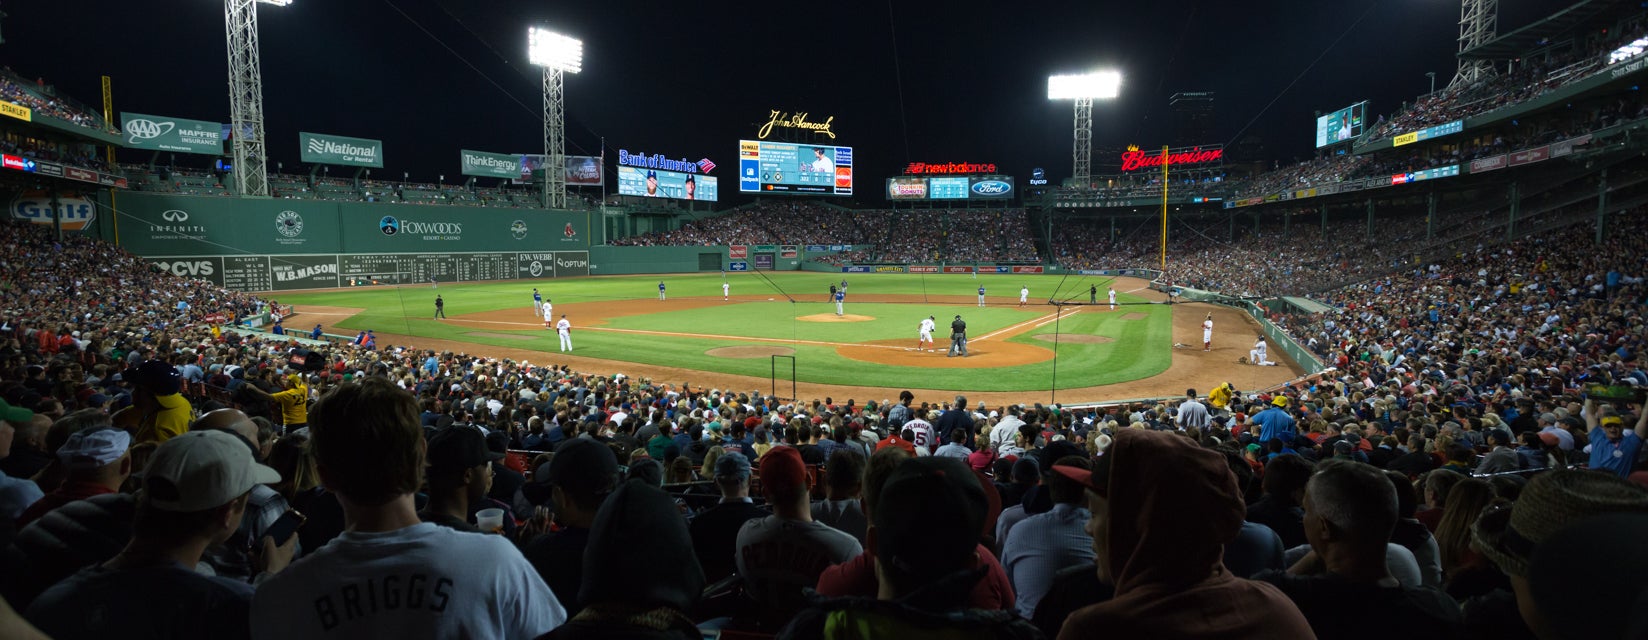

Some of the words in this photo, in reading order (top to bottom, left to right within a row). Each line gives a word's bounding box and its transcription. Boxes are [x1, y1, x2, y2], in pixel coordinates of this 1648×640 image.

[1, 103, 27, 117] STANLEY
[131, 119, 156, 137] AAA
[758, 109, 790, 139] John
[790, 112, 836, 139] Hancock
[178, 129, 218, 138] MAPFRE
[1396, 135, 1414, 144] STANLEY
[182, 138, 216, 146] INSURANCE
[324, 141, 375, 157] National
[619, 149, 648, 167] Bank
[648, 154, 658, 168] of
[659, 155, 697, 173] America
[1121, 147, 1223, 171] Budweiser
[978, 182, 1002, 194] Ford
[17, 201, 89, 219] Gulf
[401, 220, 462, 234] FOXWOODS
[172, 261, 214, 276] CVS
[564, 260, 586, 268] OPTUM
[314, 574, 453, 631] BRIGGS
